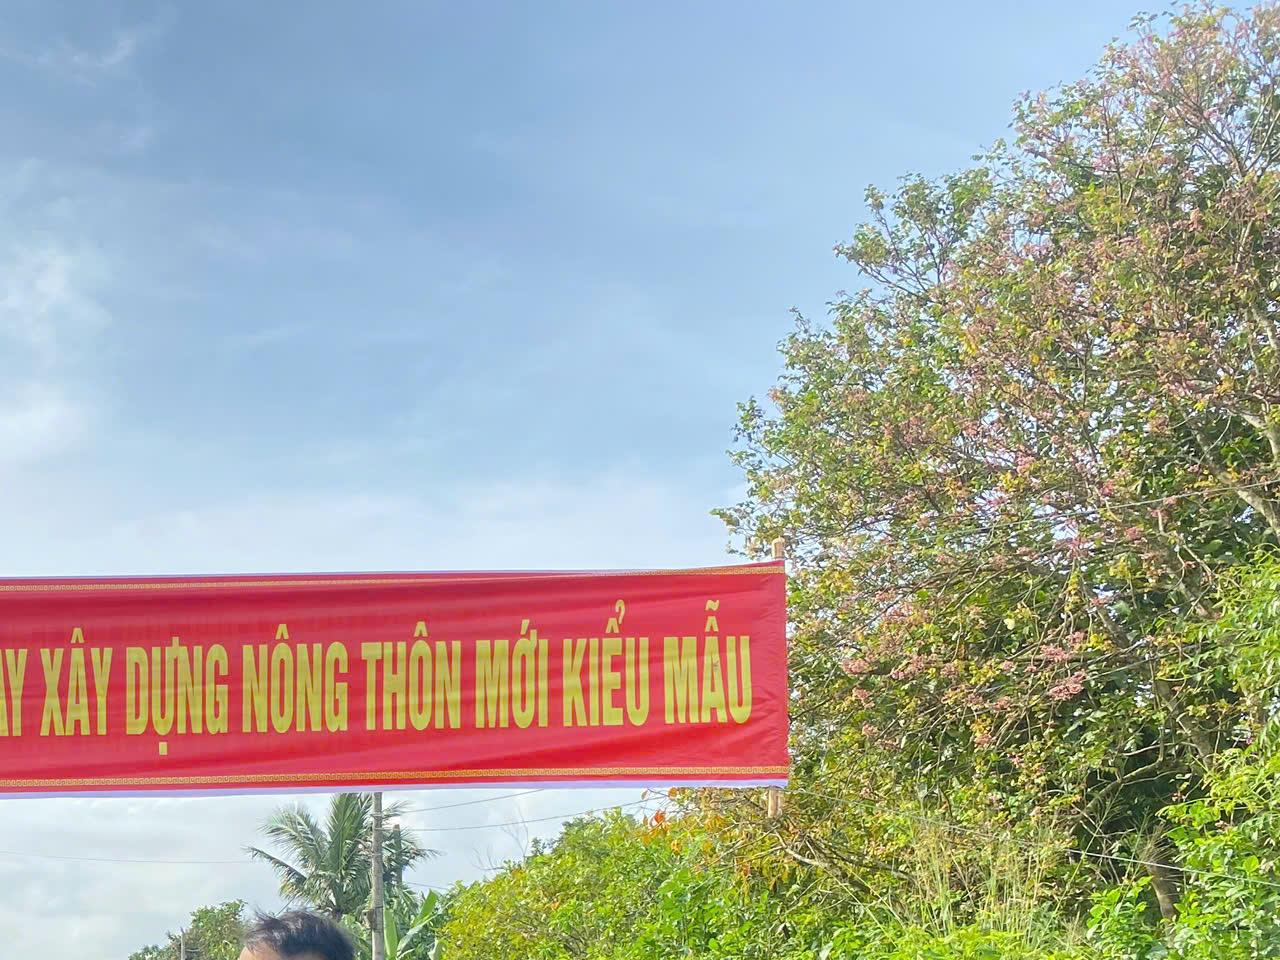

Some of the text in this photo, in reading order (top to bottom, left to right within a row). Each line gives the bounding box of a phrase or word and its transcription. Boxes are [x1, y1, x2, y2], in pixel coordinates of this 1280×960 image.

[39, 626, 113, 737] XÂY
[125, 634, 229, 757] DỰNG
[242, 622, 349, 735] NÔNG
[360, 620, 462, 731] THÔN
[475, 618, 549, 729] MỚI
[562, 598, 650, 728] KIỂU
[662, 598, 753, 726] MẪU
